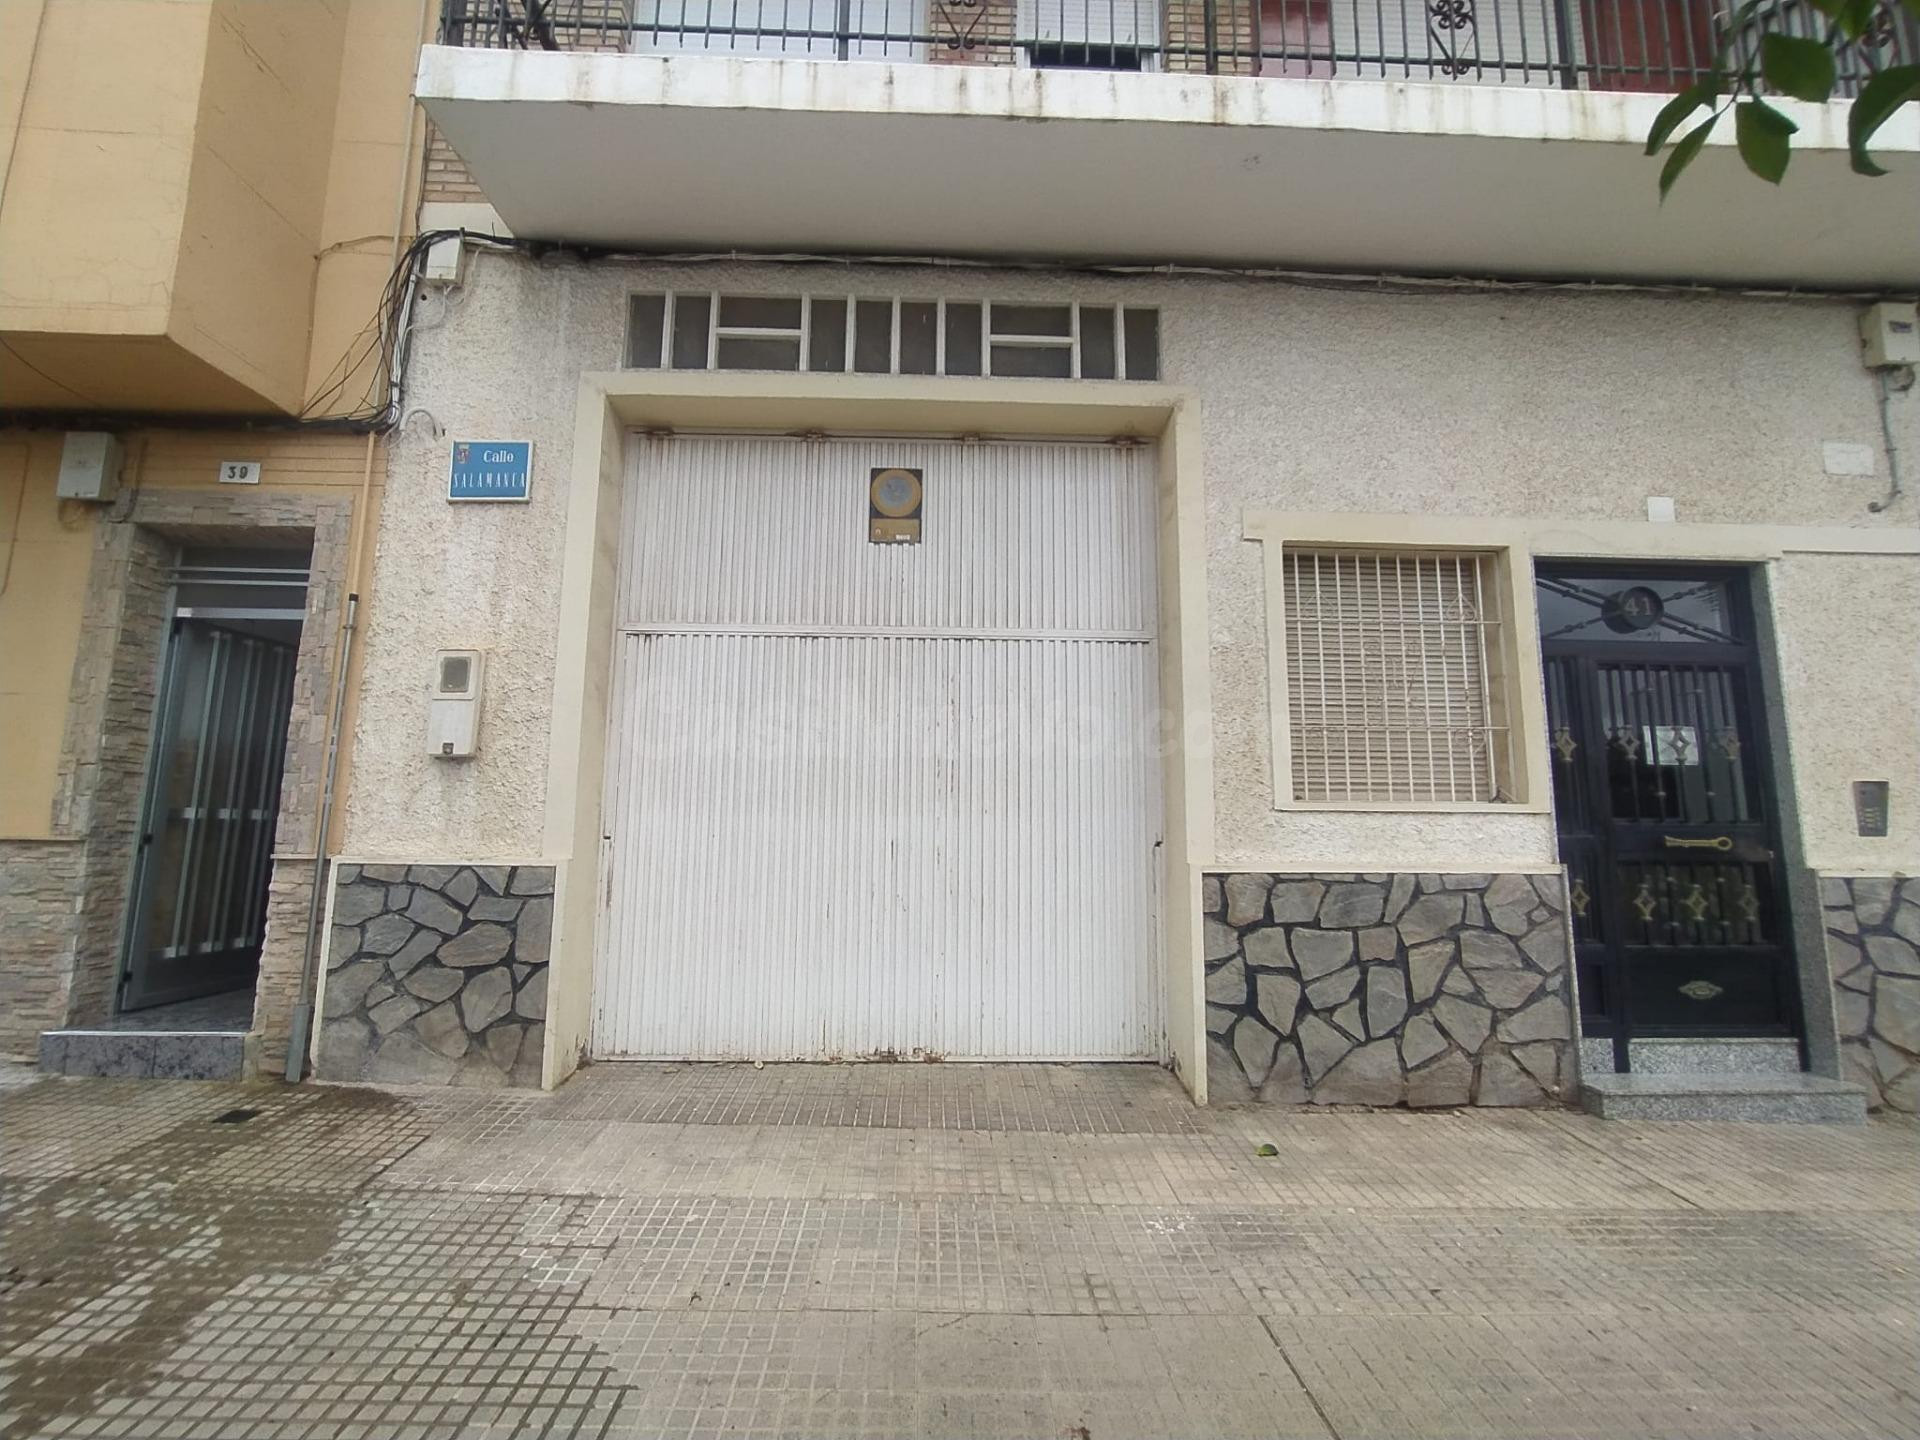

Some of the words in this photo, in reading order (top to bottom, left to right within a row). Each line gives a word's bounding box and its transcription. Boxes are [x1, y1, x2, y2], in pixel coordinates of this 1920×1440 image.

[228, 466, 248, 479] 39
[454, 472, 525, 488] SALAMANCA
[1625, 597, 1652, 616] 41
